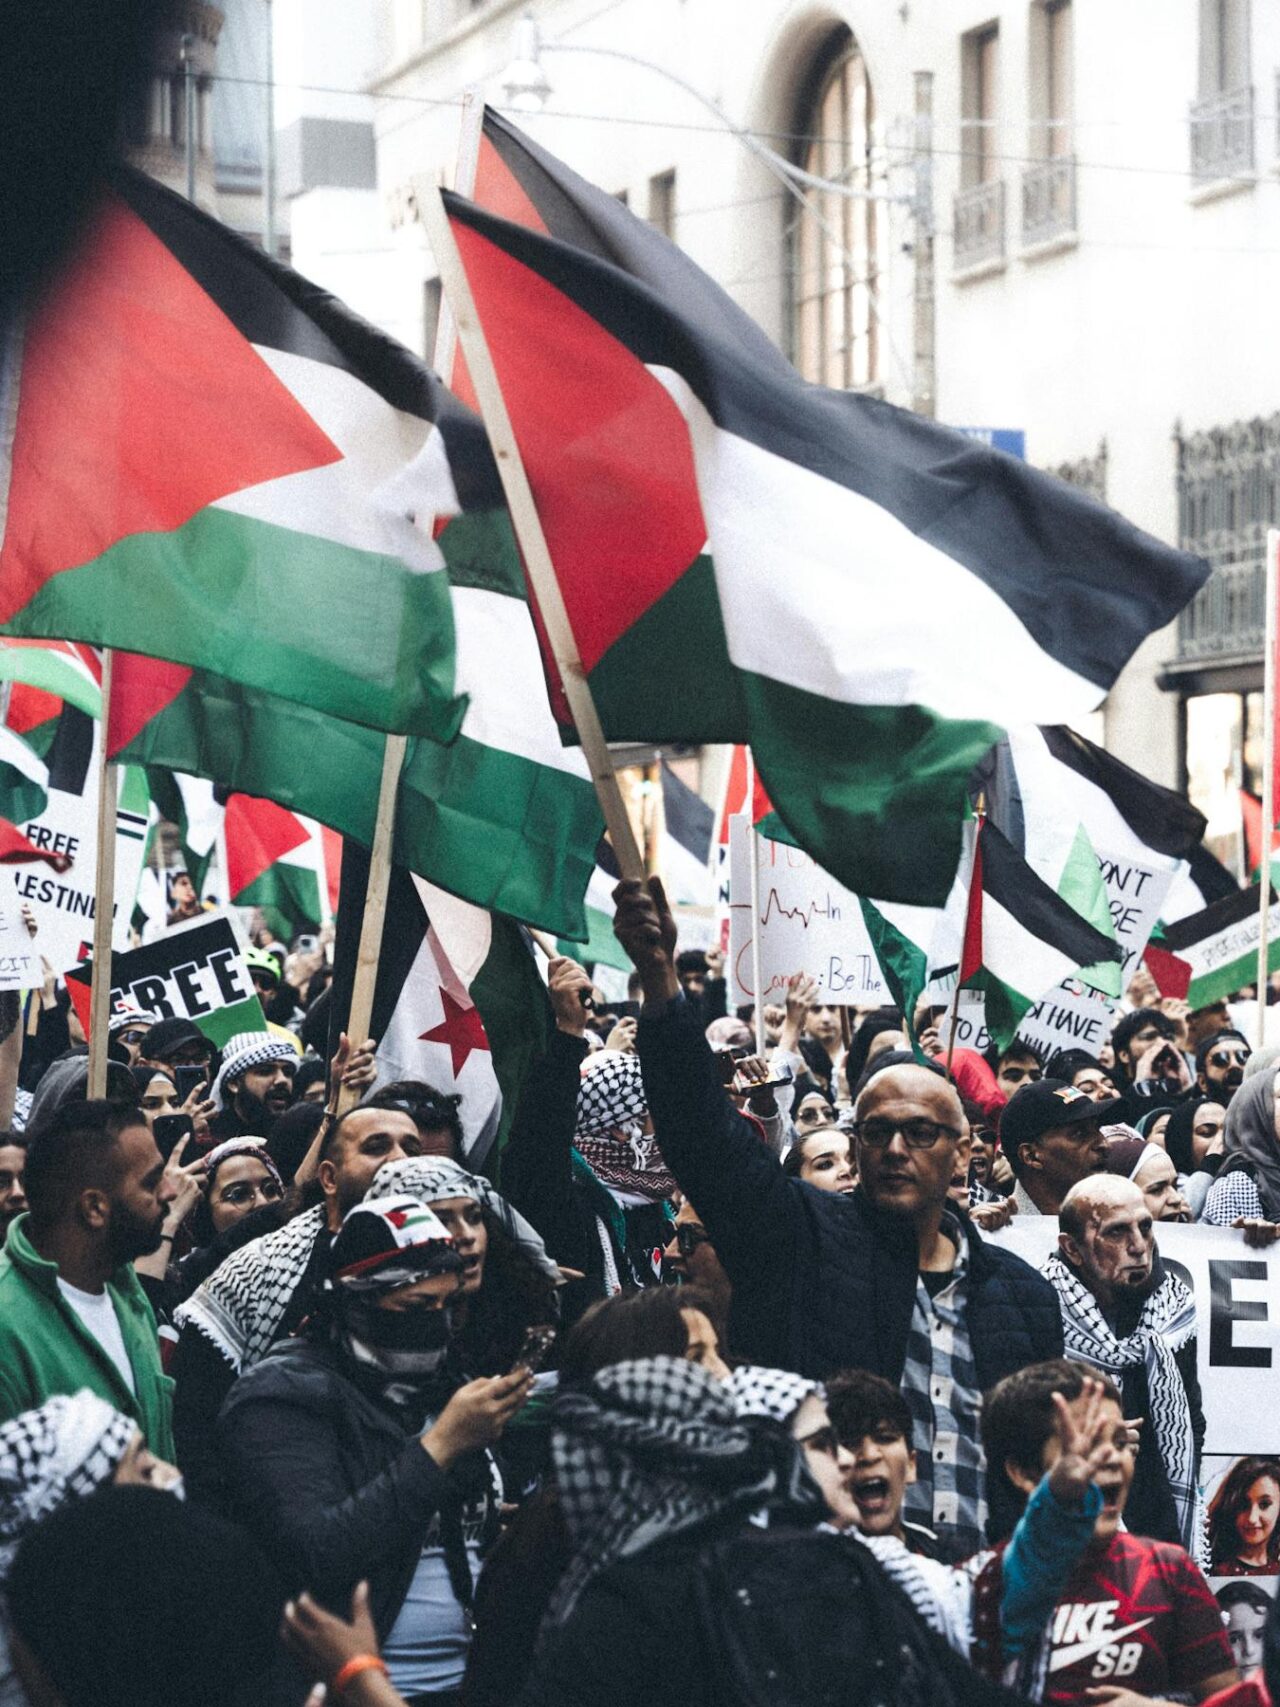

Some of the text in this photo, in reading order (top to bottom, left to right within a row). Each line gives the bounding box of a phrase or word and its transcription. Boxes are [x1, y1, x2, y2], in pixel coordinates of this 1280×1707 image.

[26, 823, 80, 861] FREE
[857, 955, 881, 991] The
[1046, 1005, 1102, 1043] HAVE
[1051, 1600, 1120, 1645] IKE
[1091, 1642, 1143, 1678] SB
